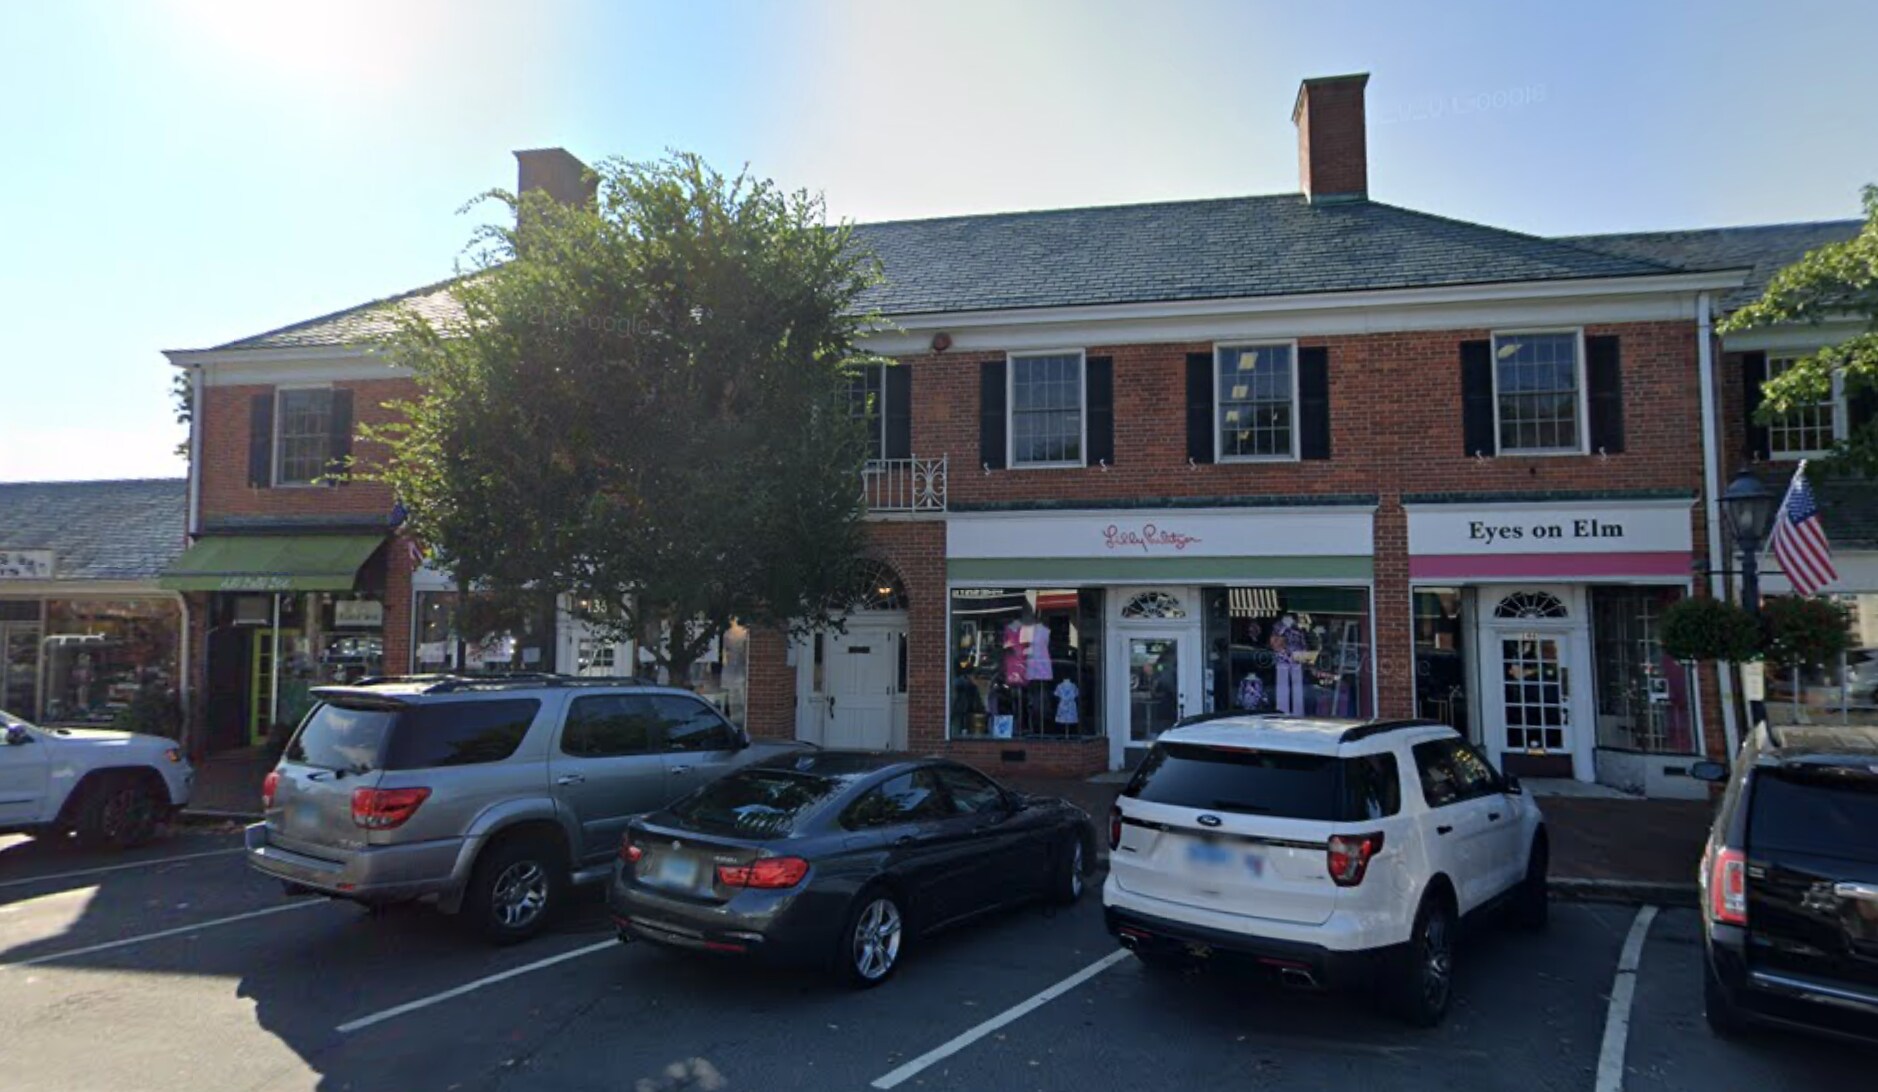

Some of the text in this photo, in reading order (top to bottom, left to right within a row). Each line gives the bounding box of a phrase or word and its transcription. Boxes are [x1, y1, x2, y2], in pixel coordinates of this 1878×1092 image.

[1102, 523, 1203, 552] Lilly Pulitzer
[1468, 518, 1624, 545] Eyes on Elm
